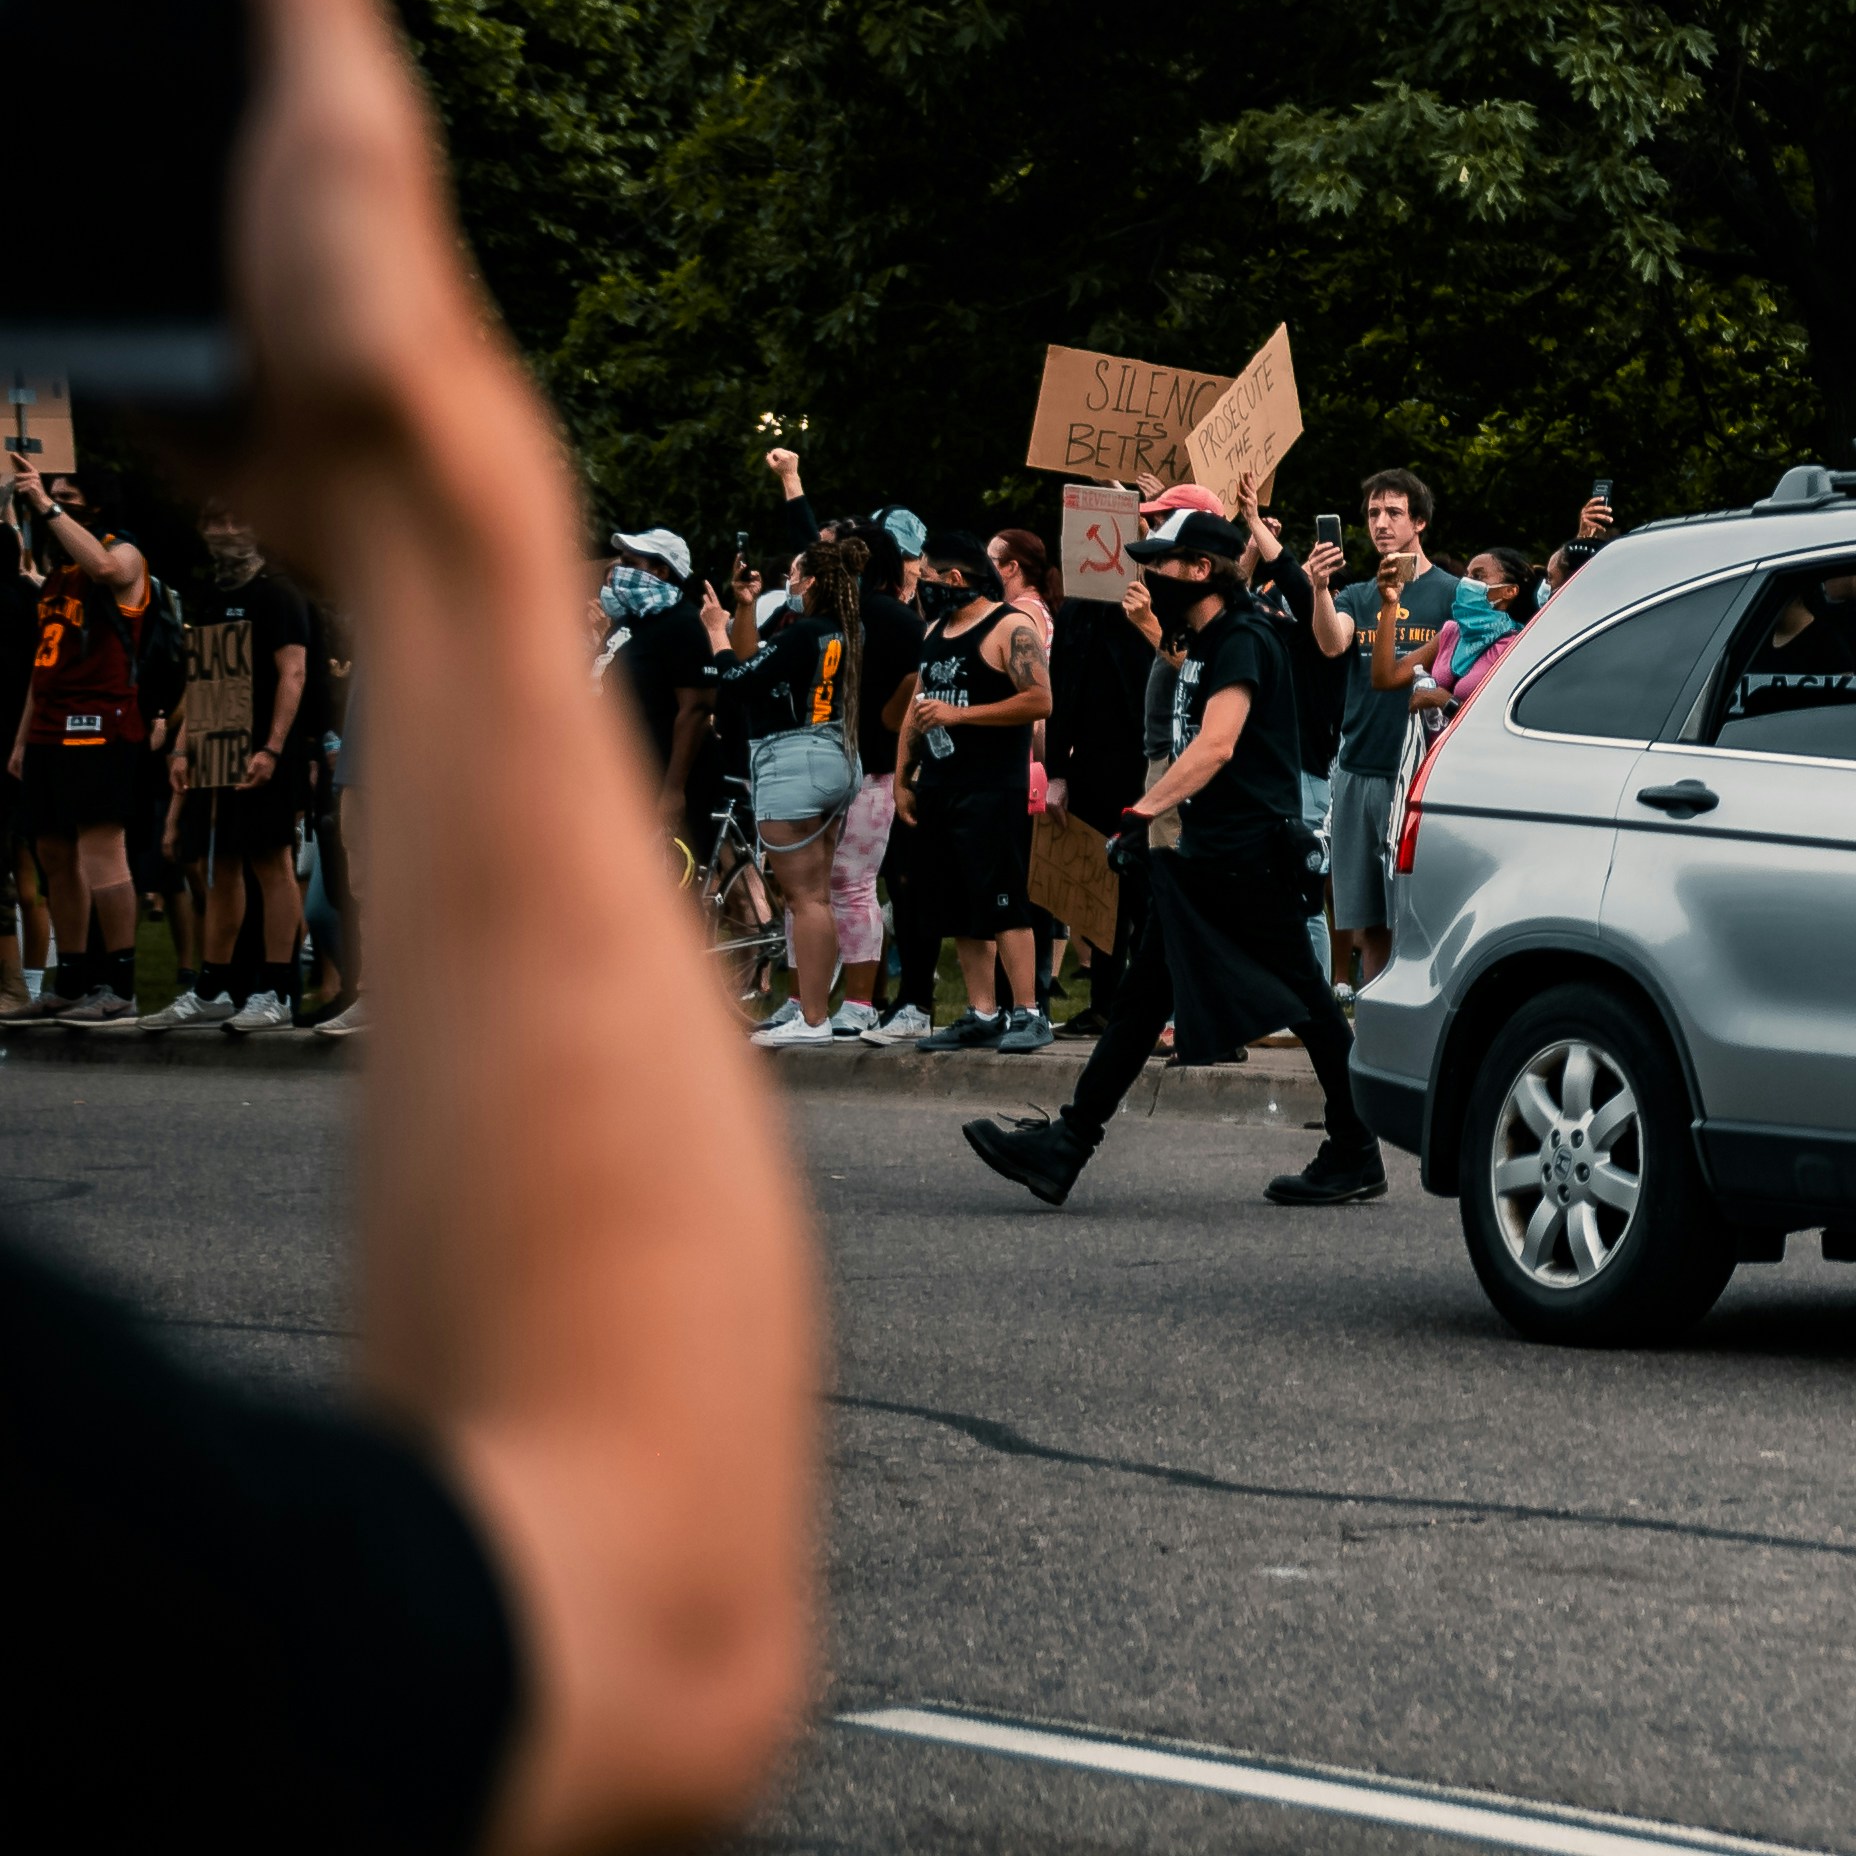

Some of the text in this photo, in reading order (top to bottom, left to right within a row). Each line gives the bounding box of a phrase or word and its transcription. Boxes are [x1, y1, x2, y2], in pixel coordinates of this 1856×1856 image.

[1086, 359, 1217, 430] SILENC
[1199, 353, 1273, 467] PROSECUTE
[1135, 421, 1167, 440] IS
[1224, 426, 1252, 470] THE
[1216, 431, 1276, 508] POICE
[183, 624, 252, 681] BLACK
[186, 682, 252, 732] LIVES
